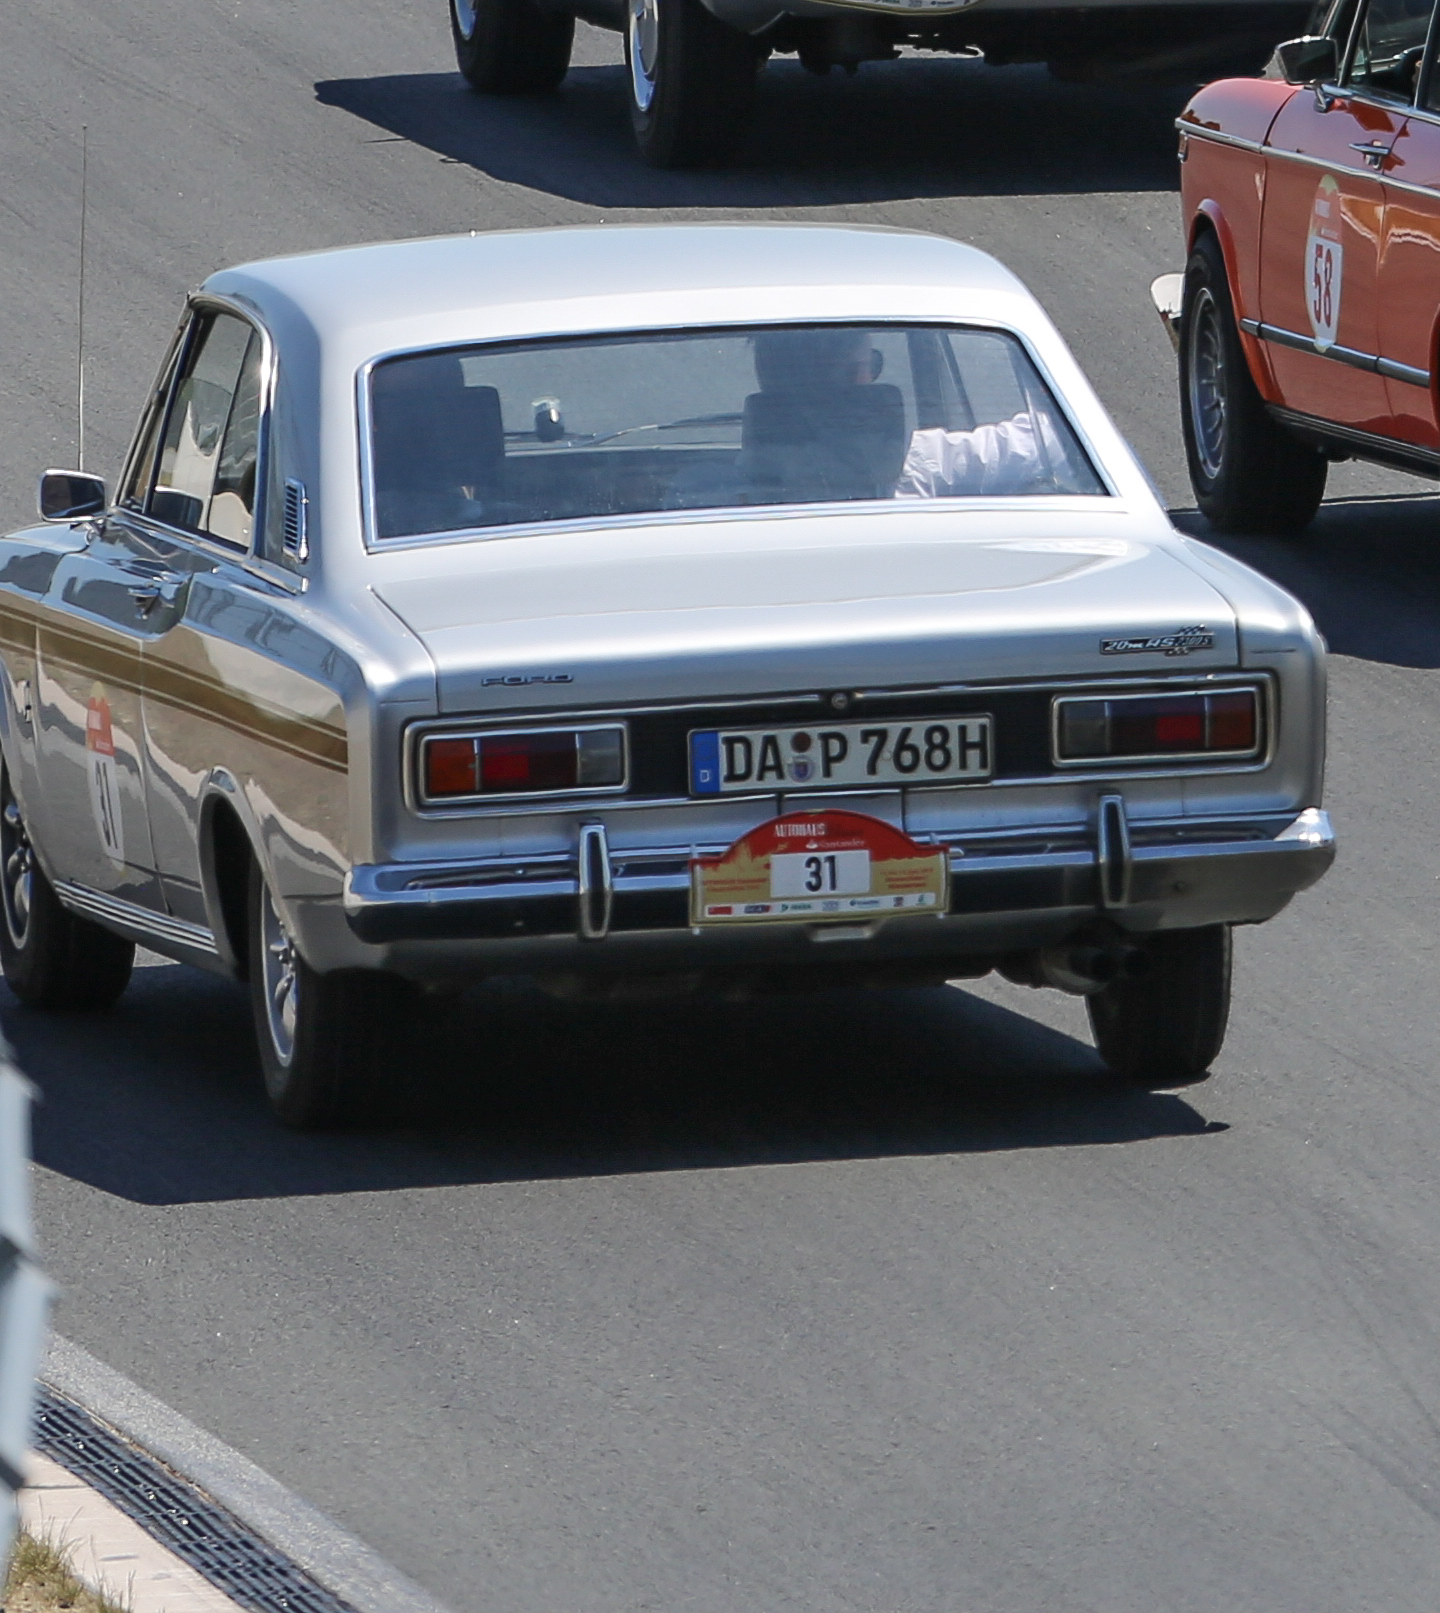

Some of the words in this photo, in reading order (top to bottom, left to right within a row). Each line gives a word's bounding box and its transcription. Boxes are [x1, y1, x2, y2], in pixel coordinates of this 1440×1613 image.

[1314, 244, 1333, 328] 58
[481, 674, 573, 687] FORD
[722, 734, 785, 783] DA
[817, 731, 848, 778] P
[860, 723, 988, 776] 768H
[96, 761, 118, 849] 31
[805, 855, 837, 892] 31
